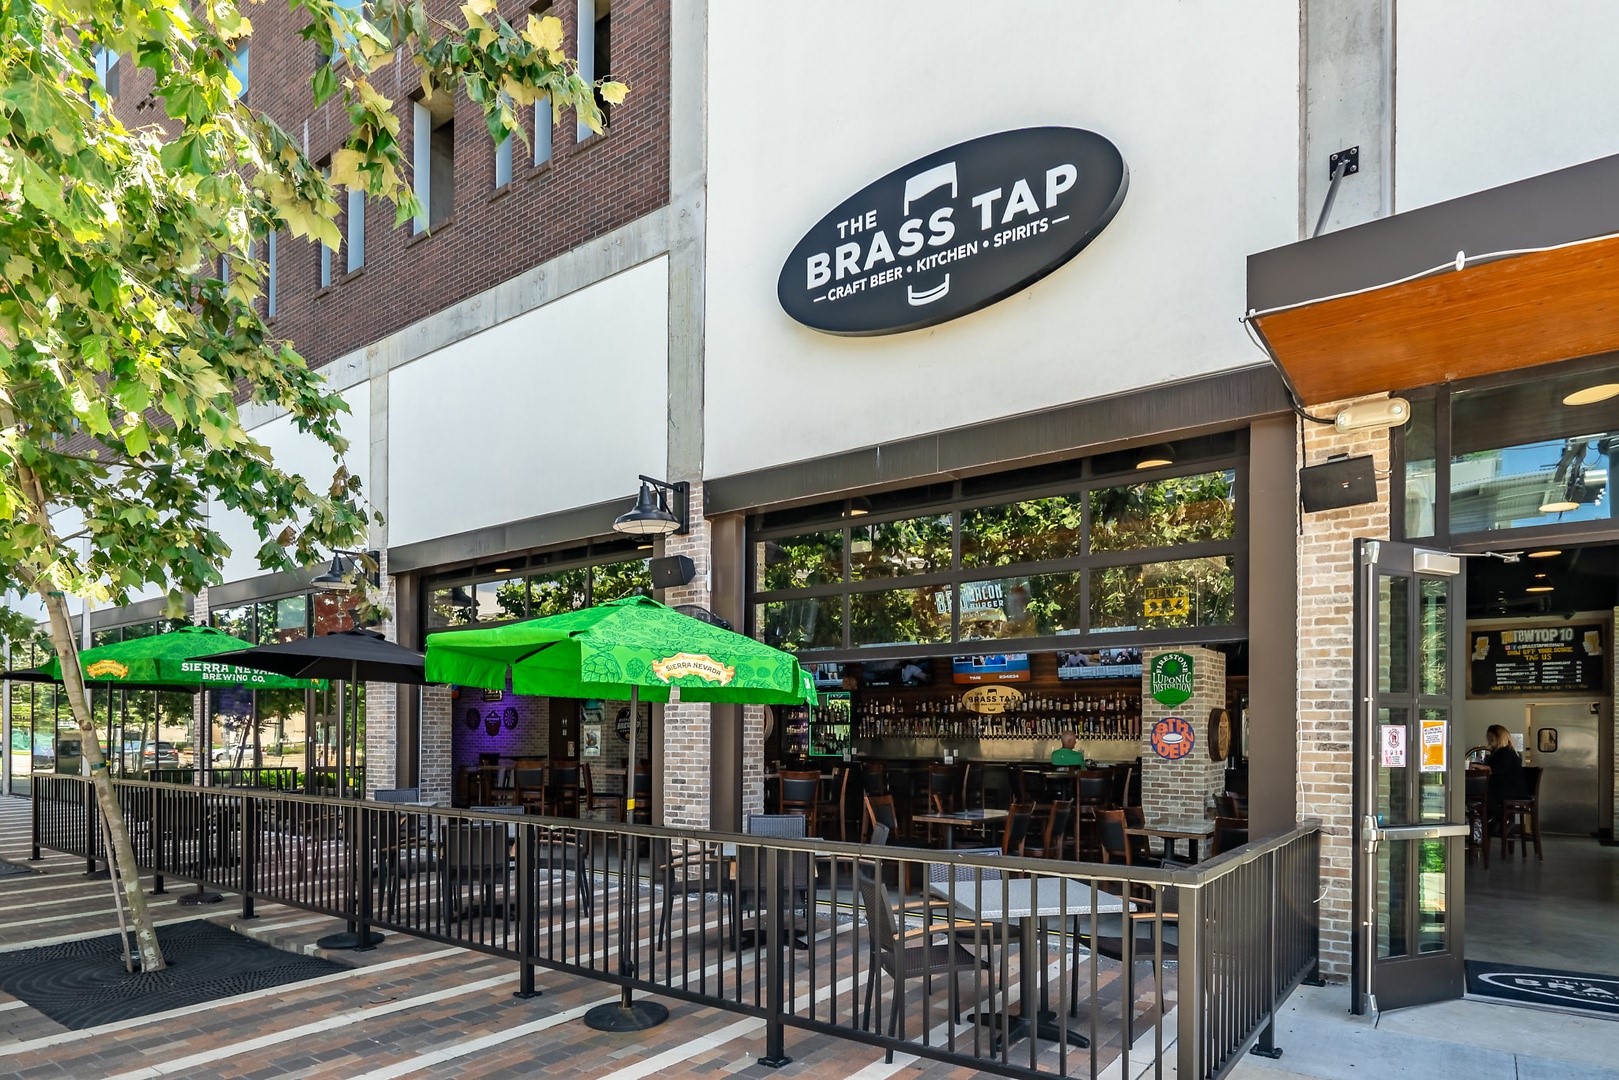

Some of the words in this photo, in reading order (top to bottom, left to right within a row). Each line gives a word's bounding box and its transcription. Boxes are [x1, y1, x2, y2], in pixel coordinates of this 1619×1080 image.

[807, 207, 955, 290] BRASS
[972, 164, 1078, 230] TAP
[837, 209, 877, 239] THE
[828, 278, 867, 301] CRAFT
[870, 266, 903, 288] BEER
[916, 241, 978, 273] KITCHEN
[994, 218, 1049, 248] SPIRITS
[181, 662, 229, 674] SIERRA
[665, 662, 692, 672] SIERRA
[692, 662, 722, 676] NEVADA
[1156, 654, 1189, 674] FIRESTONE
[251, 675, 266, 683] CO.
[1152, 671, 1192, 684] LUPONIC
[1152, 682, 1191, 695] DISTORTION
[968, 695, 997, 703] BRASS
[1156, 718, 1189, 733] 8TH
